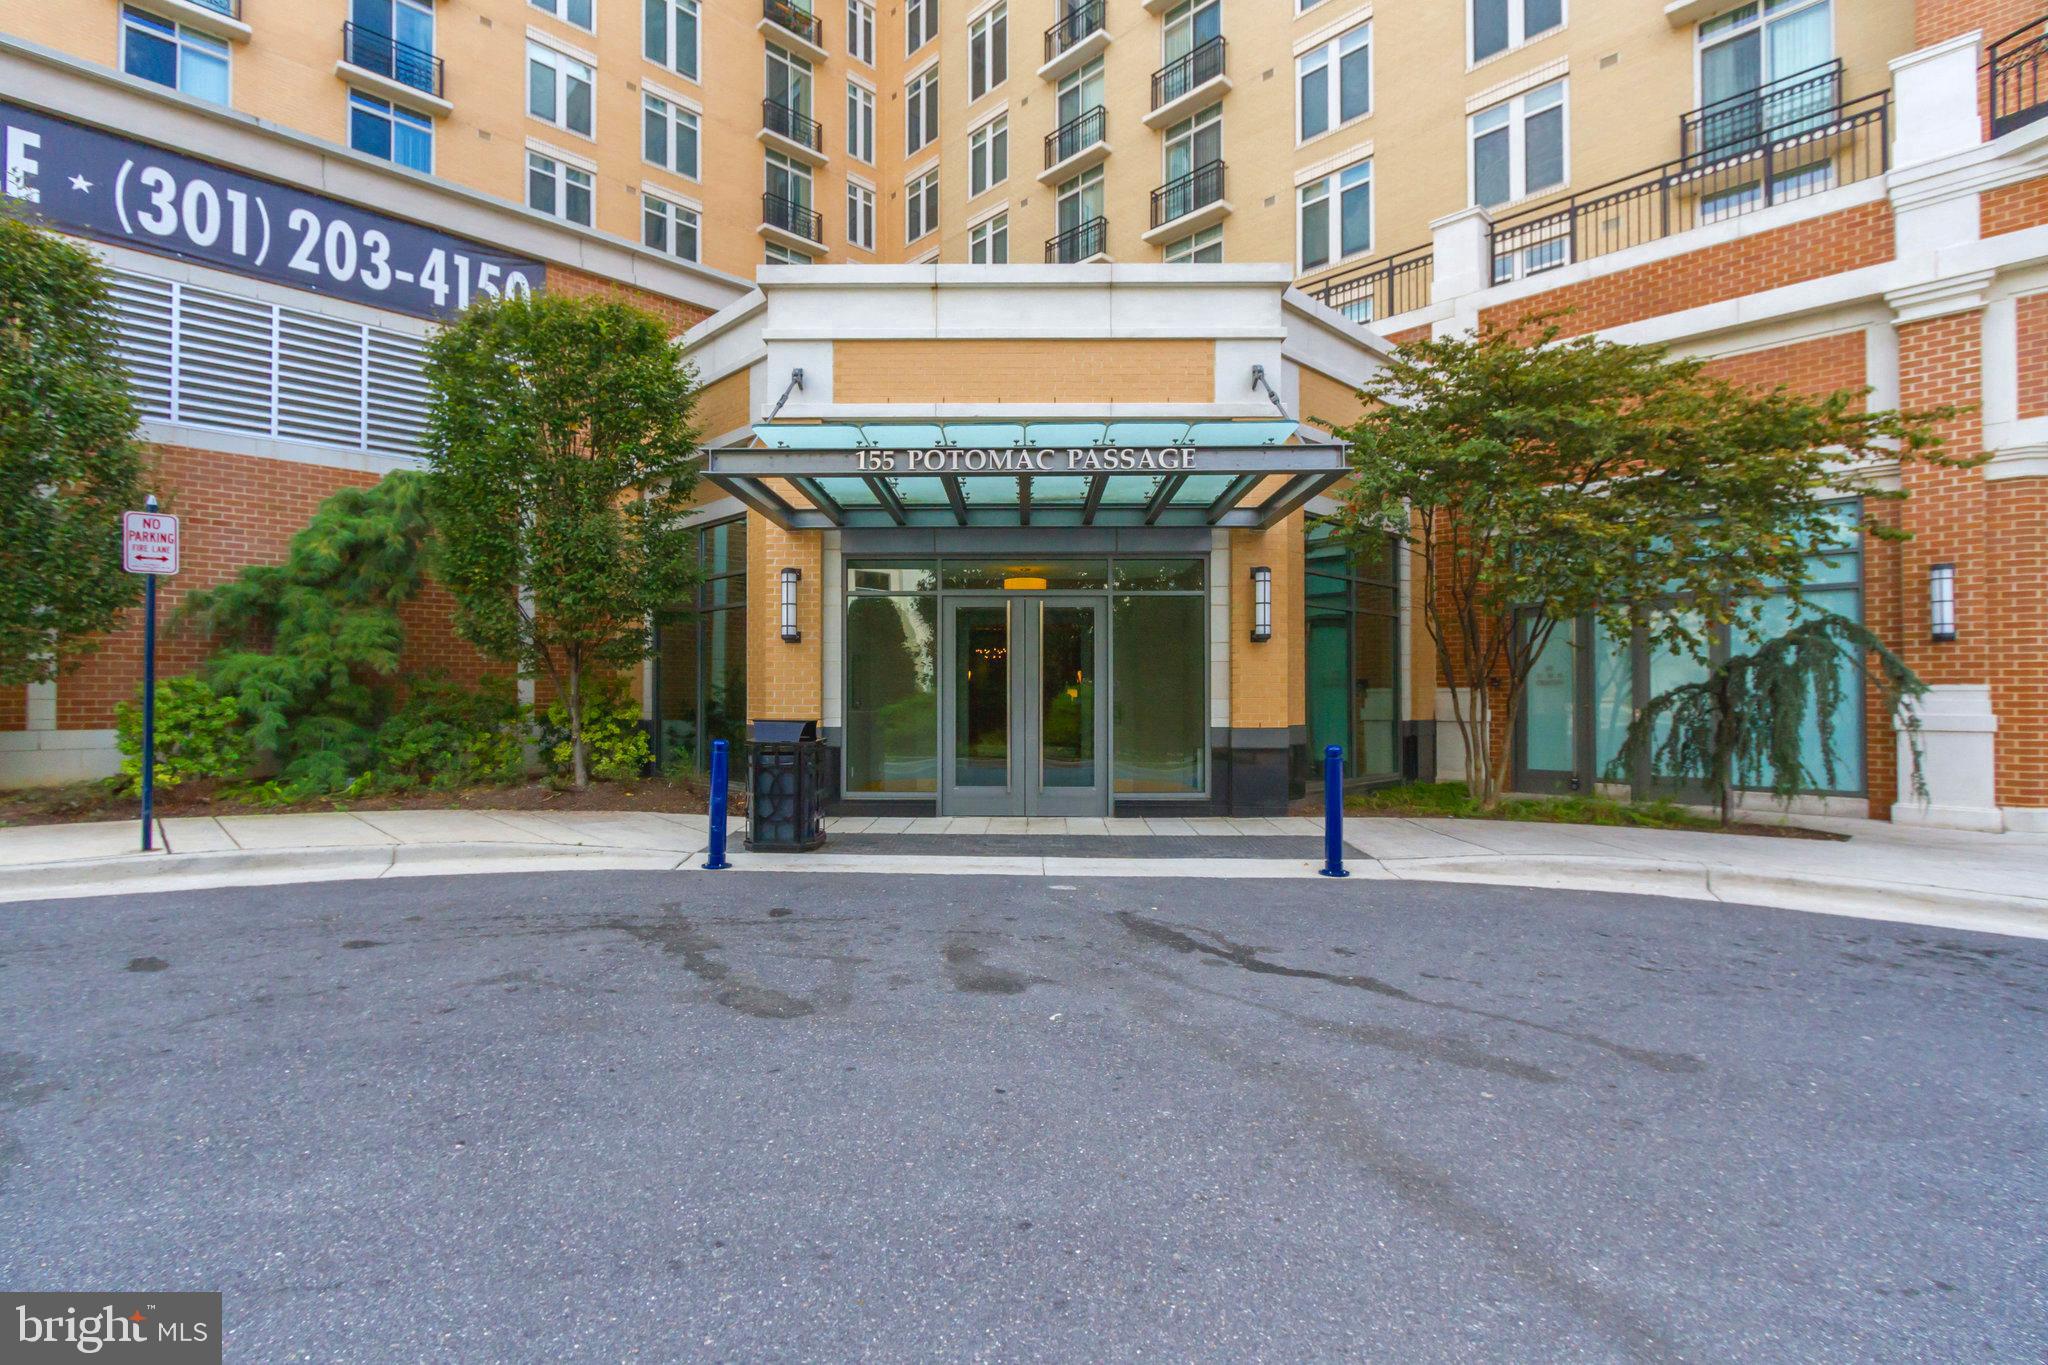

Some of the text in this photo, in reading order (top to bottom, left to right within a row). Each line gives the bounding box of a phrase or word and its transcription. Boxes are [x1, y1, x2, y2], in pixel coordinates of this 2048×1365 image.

[6, 125, 41, 204] E
[115, 159, 270, 266] (301)
[856, 448, 1197, 471] 155 POTOMAC PASSAGE
[143, 518, 161, 530] NO
[128, 530, 174, 544] PARKING
[132, 544, 170, 554] FIRE LANE
